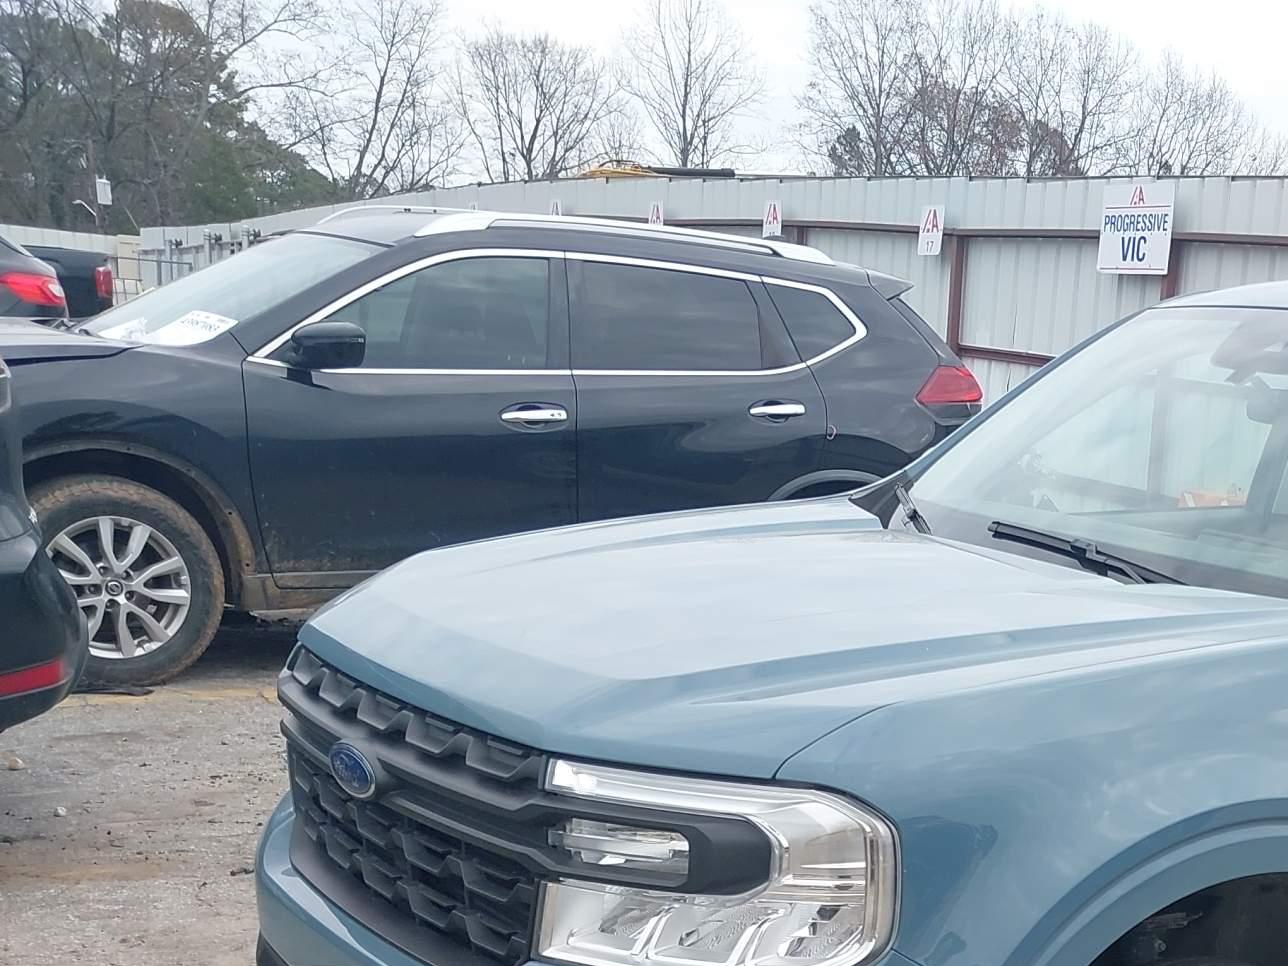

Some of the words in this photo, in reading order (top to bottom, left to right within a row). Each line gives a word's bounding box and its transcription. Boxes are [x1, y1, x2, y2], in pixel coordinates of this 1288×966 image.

[1104, 213, 1169, 233] PROGRESSIVE
[926, 240, 934, 253] 17
[1121, 236, 1147, 262] VIC
